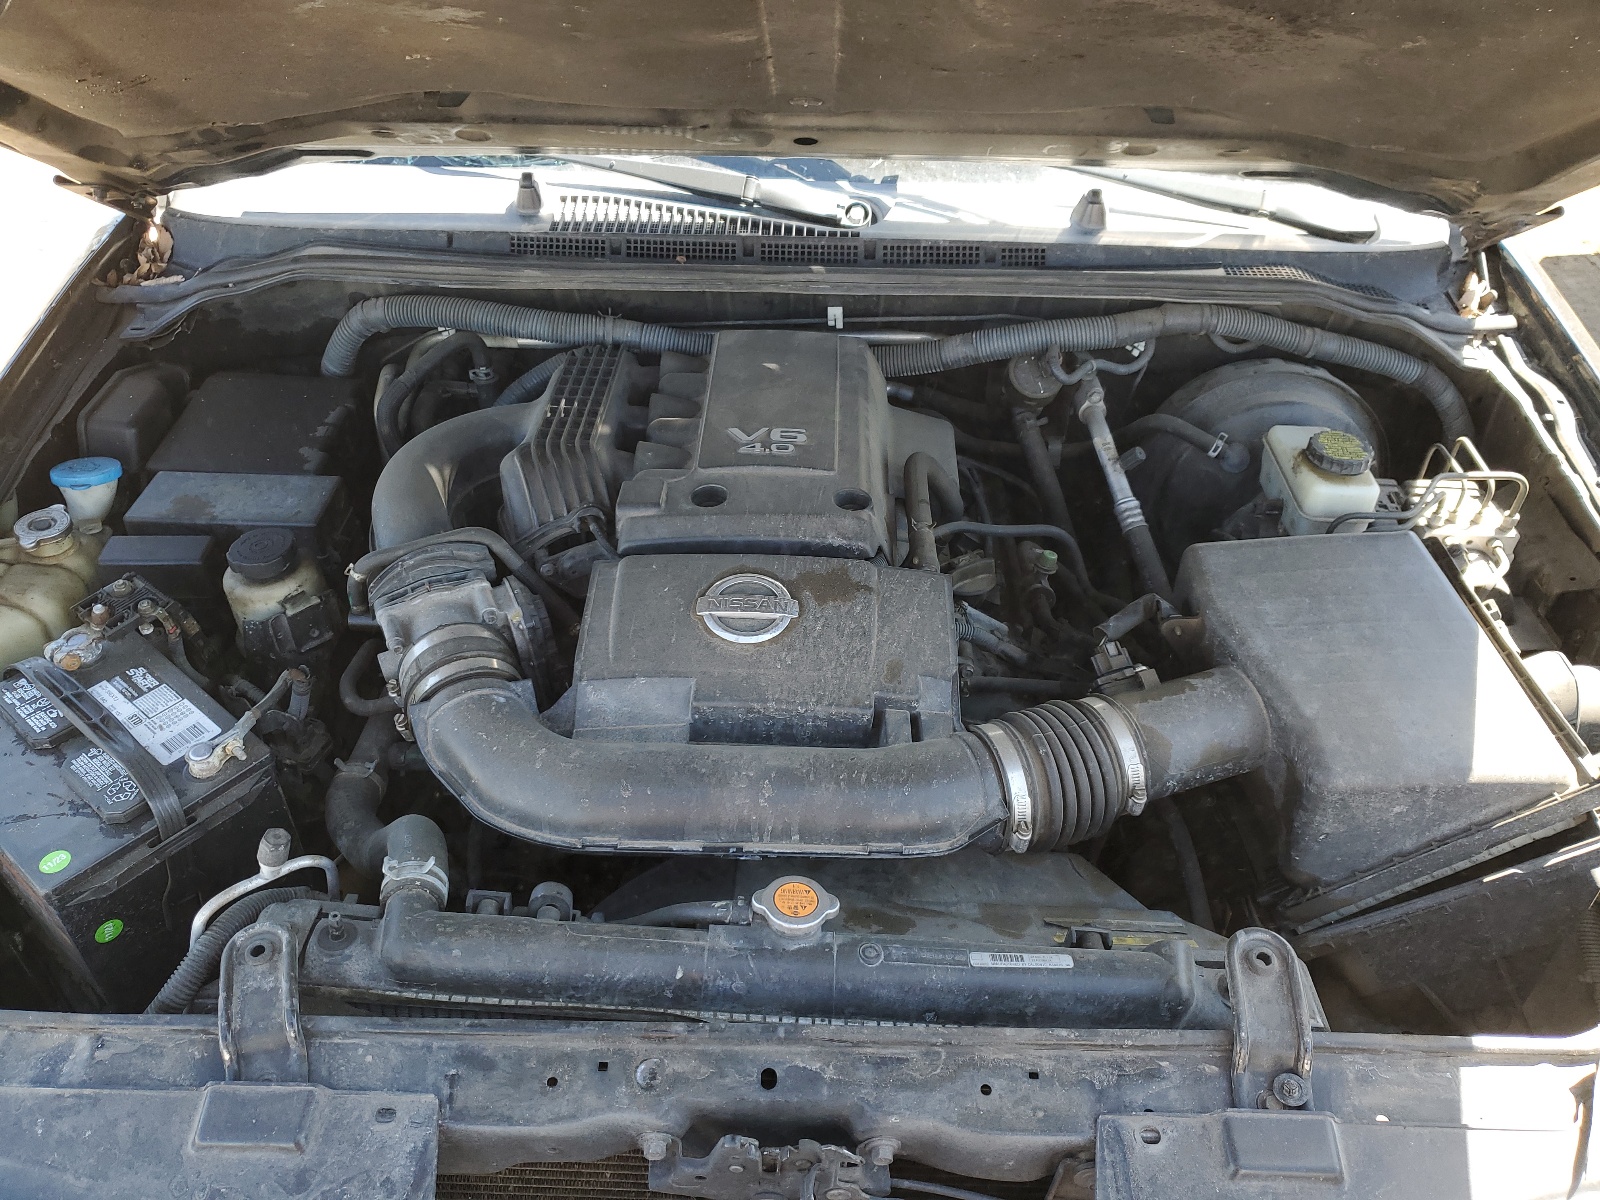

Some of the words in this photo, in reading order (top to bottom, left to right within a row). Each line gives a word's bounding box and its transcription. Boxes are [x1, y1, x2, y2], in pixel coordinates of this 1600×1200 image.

[727, 427, 808, 444] V6
[737, 443, 796, 455] 4.0
[707, 597, 790, 613] NISSAN
[128, 713, 143, 727] STD
[41, 853, 67, 871] 11/23
